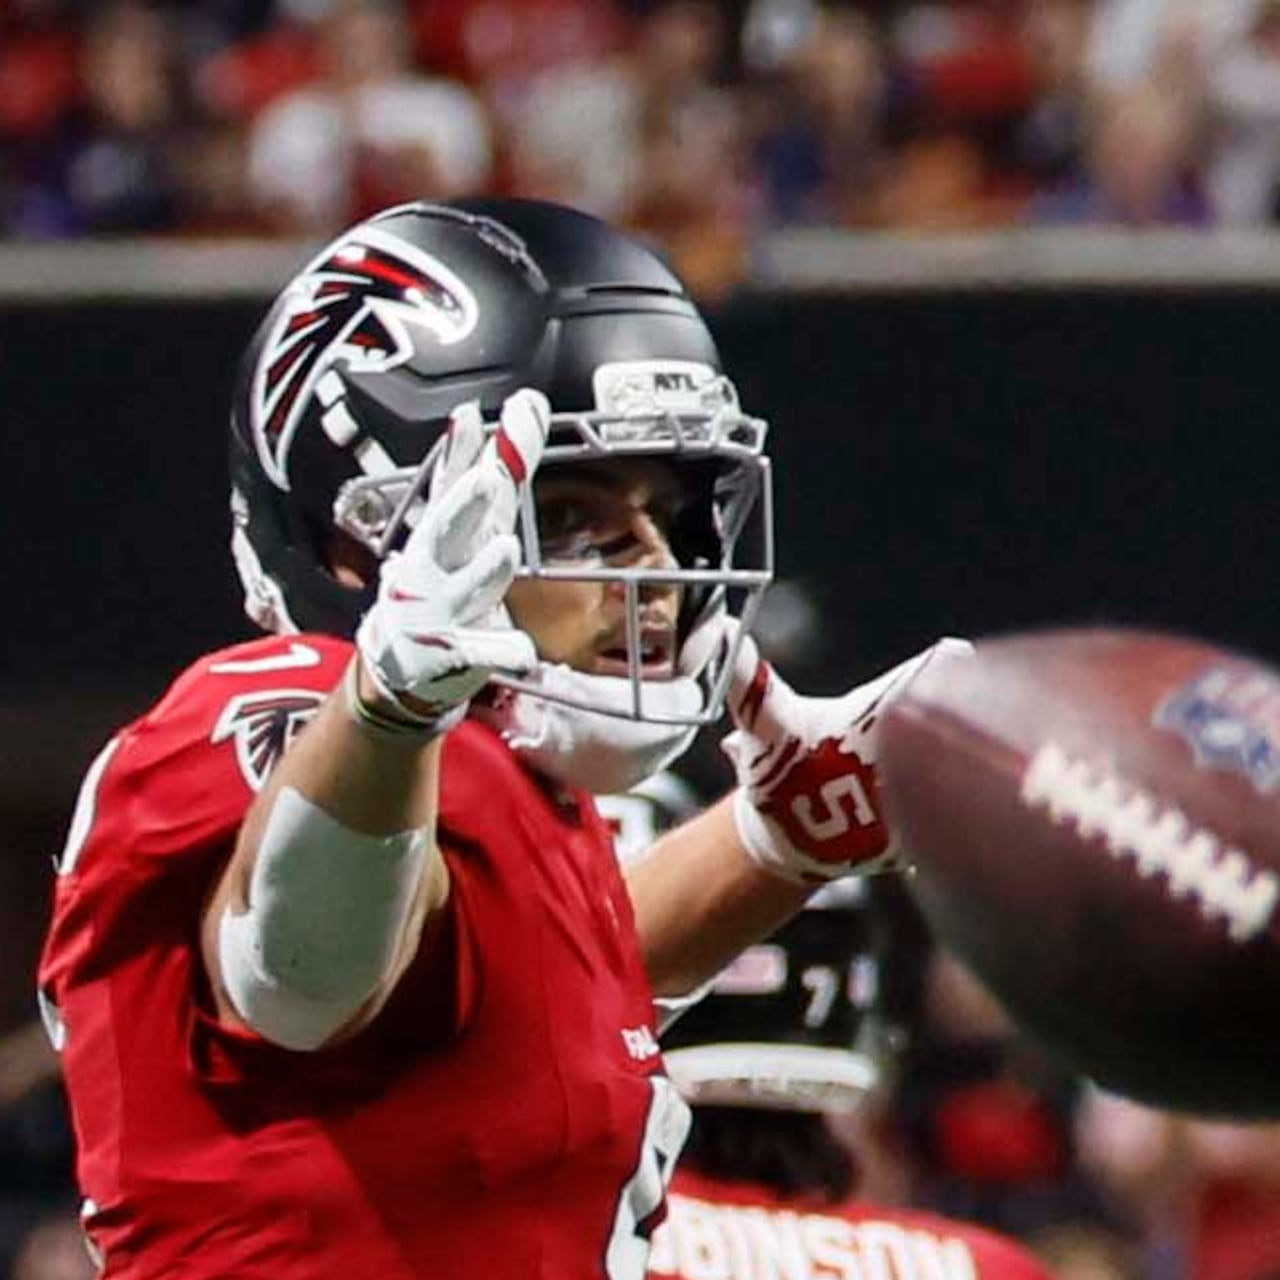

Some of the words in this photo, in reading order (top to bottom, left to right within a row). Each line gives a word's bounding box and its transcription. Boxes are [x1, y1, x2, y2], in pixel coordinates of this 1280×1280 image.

[654, 373, 698, 391] ATL
[791, 773, 876, 841] 5
[800, 966, 839, 1029] 7
